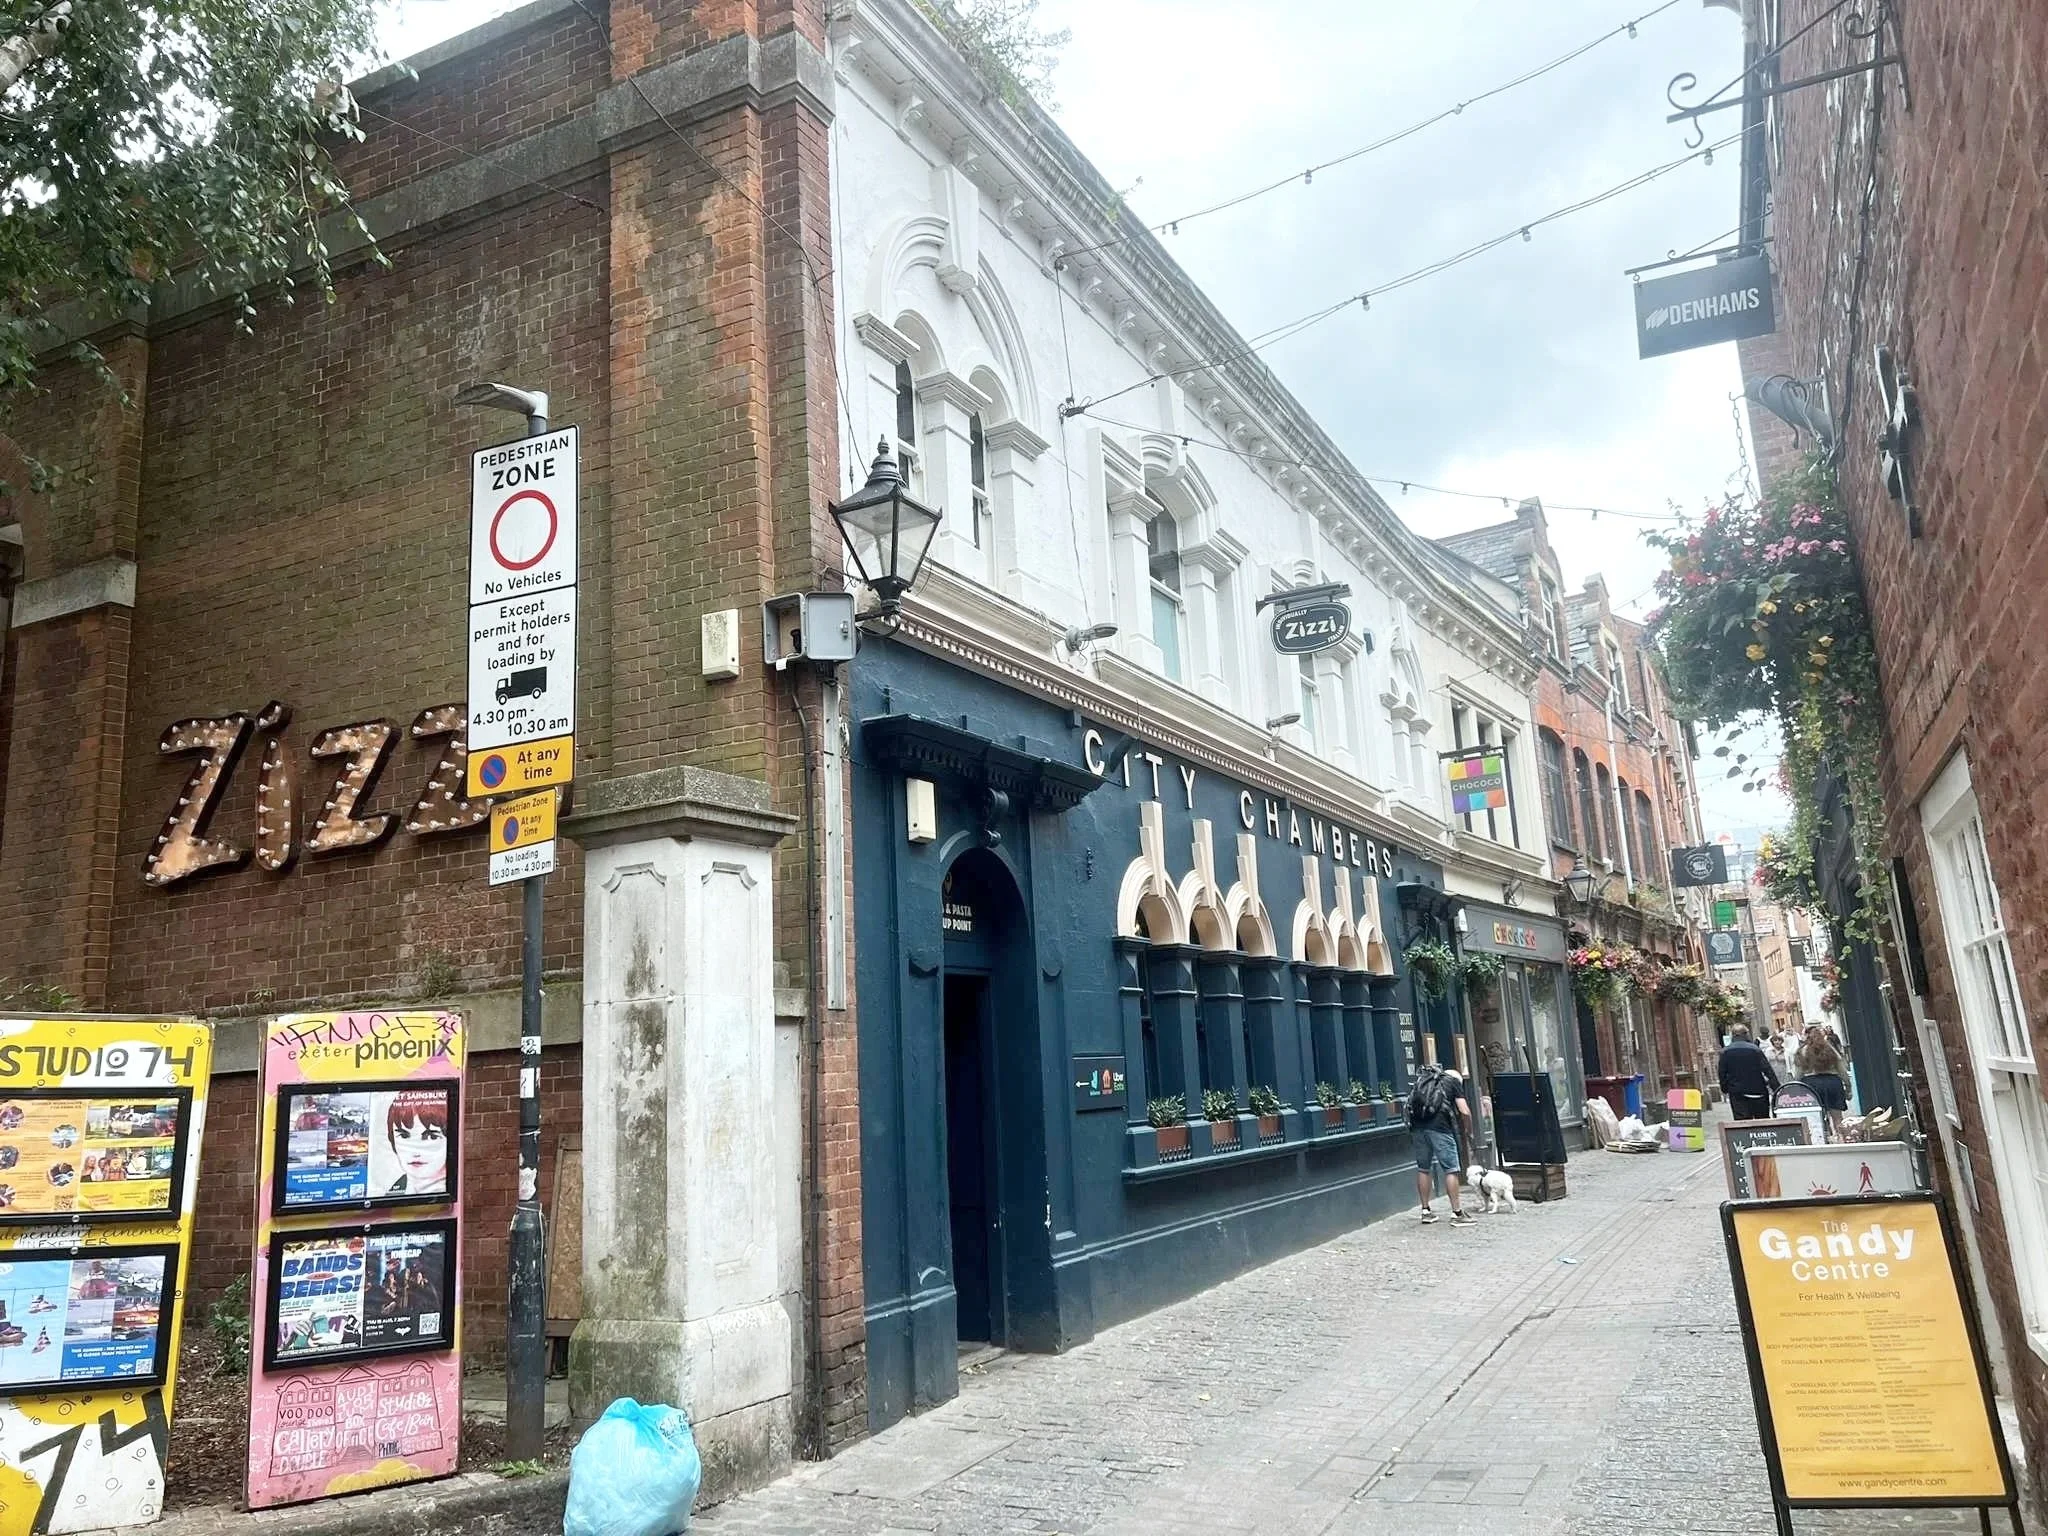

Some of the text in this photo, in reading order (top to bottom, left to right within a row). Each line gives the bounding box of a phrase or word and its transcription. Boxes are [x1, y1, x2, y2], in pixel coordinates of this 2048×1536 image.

[1669, 287, 1760, 326] DENHAMS
[480, 435, 569, 469] PEDESTRIAN
[492, 457, 555, 491] ZONE
[485, 570, 562, 595] No Vehicles
[500, 599, 545, 619] Except
[474, 612, 571, 642] permit holders
[1285, 615, 1336, 640] Zizzi
[498, 633, 545, 652] and for
[487, 648, 556, 671] loading by
[473, 709, 505, 726] 4.30
[508, 707, 527, 722] pm
[507, 717, 569, 736] 10.30 am
[517, 747, 560, 765] At any
[524, 766, 553, 780] time
[497, 796, 548, 816] Pedestrian Zone
[1083, 728, 1394, 879] CITY CHAMBERS
[521, 814, 542, 825] At any
[524, 827, 538, 837] time
[504, 849, 539, 865] No loading
[491, 867, 511, 881] 10.30
[511, 866, 520, 875] am
[524, 860, 541, 874] 4.30
[541, 860, 552, 870] pm
[952, 904, 973, 917] PASTA
[952, 918, 972, 932] POINT
[0, 1044, 195, 1078] STUDIO 74
[287, 1034, 456, 1069] exeter phoenix
[1821, 1220, 1848, 1233] The
[38, 1237, 111, 1249] EXETER
[1759, 1223, 1914, 1260] Gandy
[283, 1254, 364, 1278] BANDS
[1791, 1260, 1889, 1281] Centre
[280, 1275, 362, 1300] BEERS!
[1798, 1289, 1901, 1301] For Health & Wellbeing
[1838, 1477, 1947, 1489] www.gandycentre.com
